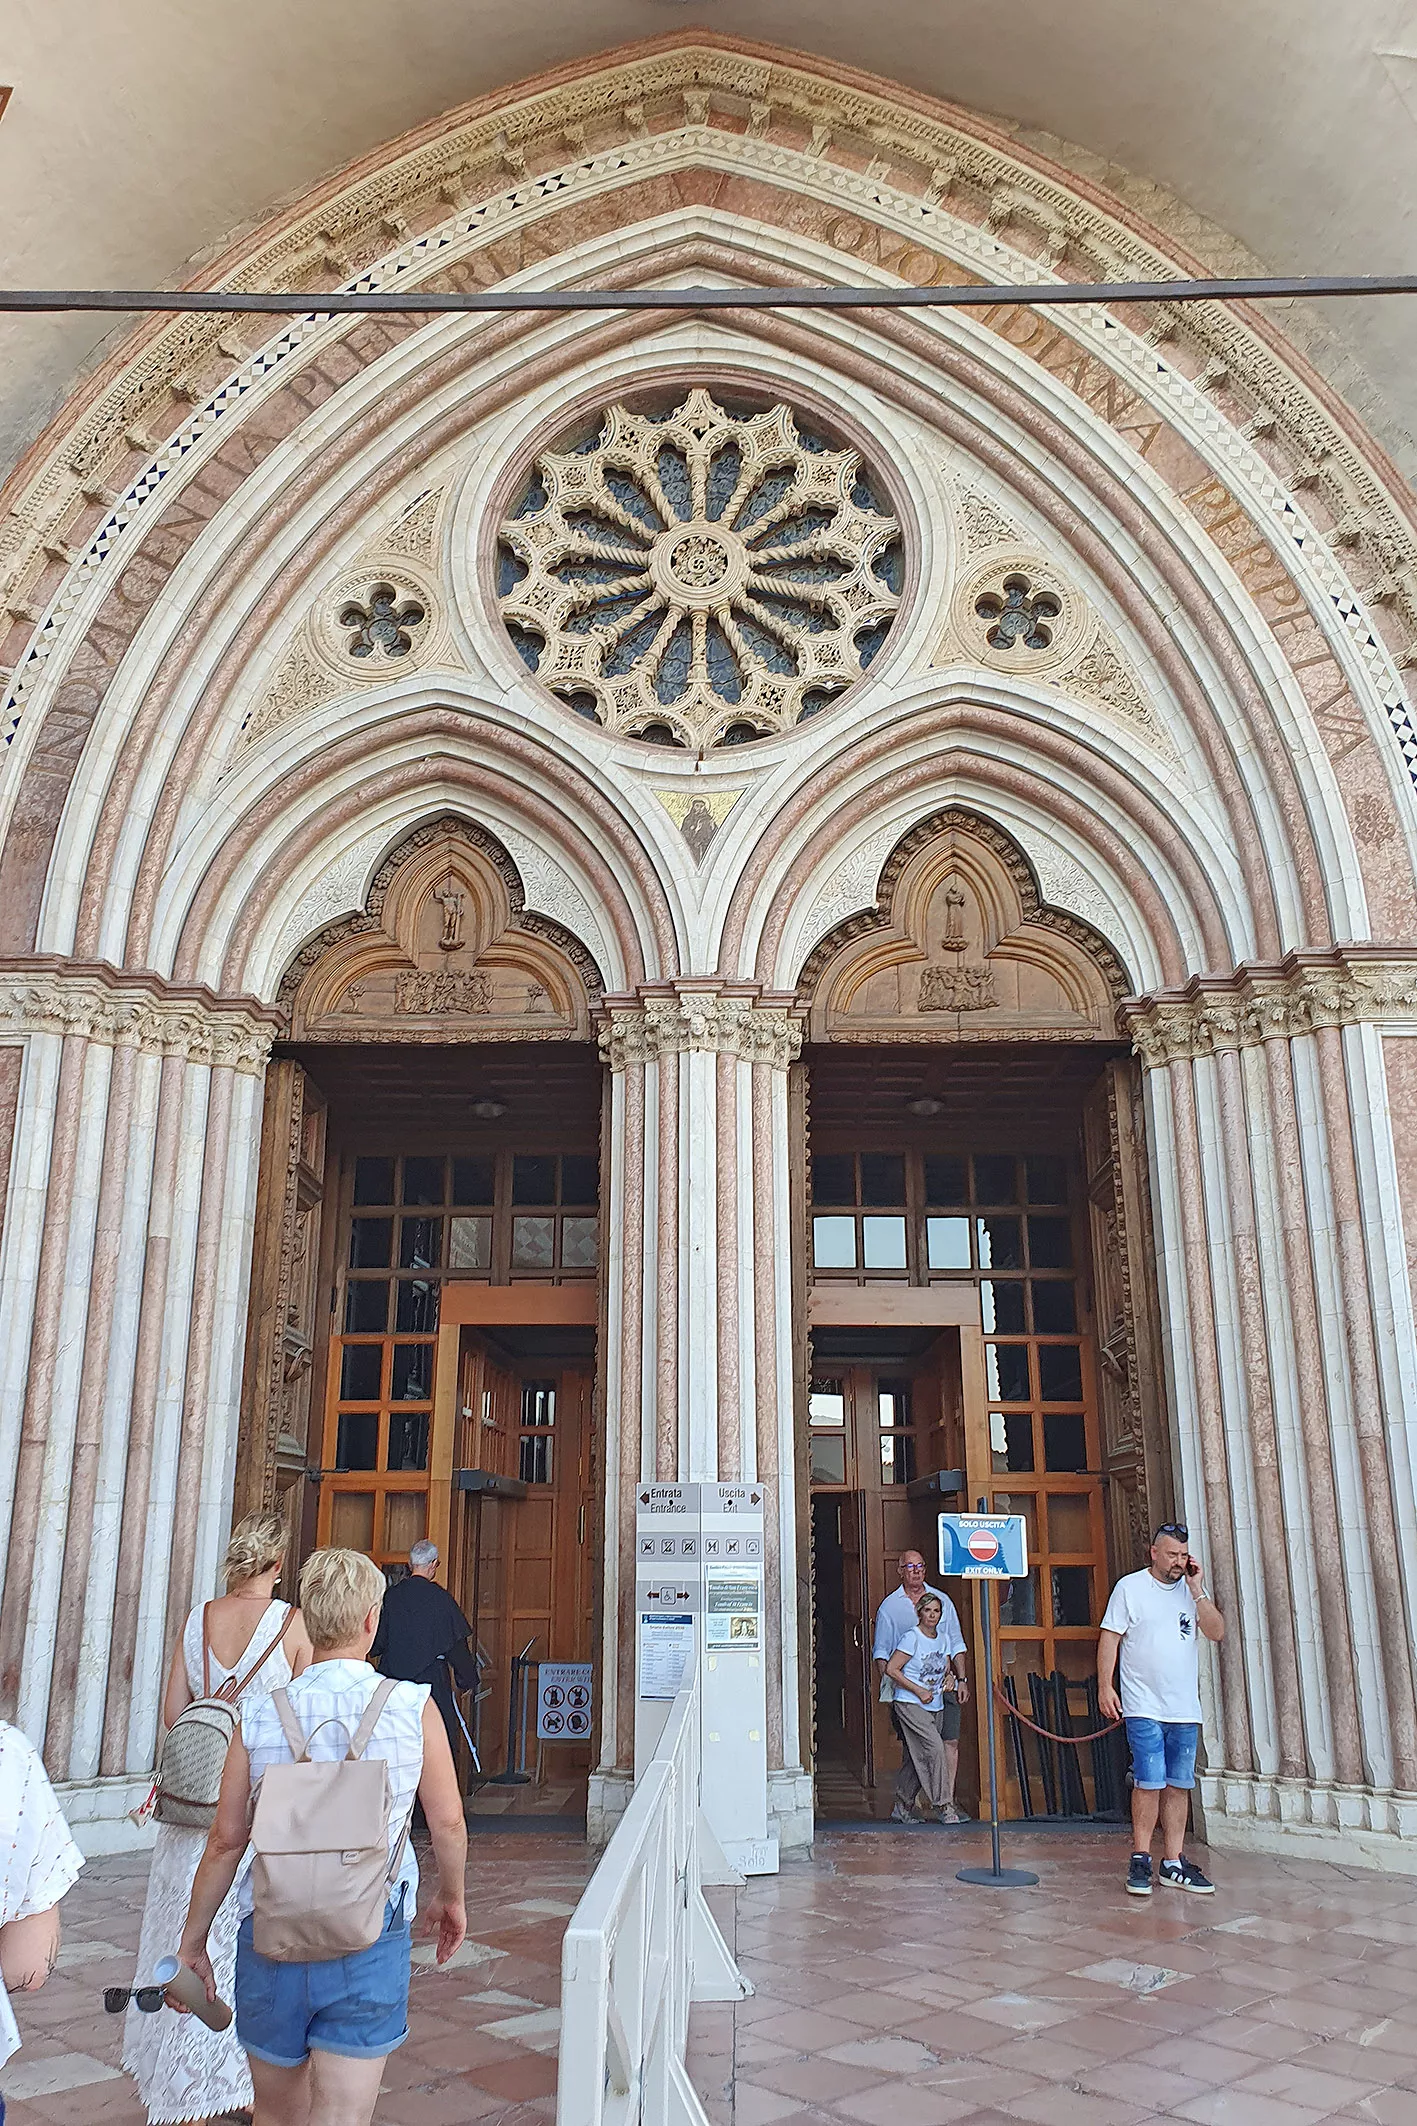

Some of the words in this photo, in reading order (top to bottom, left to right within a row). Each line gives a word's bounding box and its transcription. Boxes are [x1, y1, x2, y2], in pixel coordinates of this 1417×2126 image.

[283, 229, 557, 413] PLENRIA
[651, 1488, 682, 1498] Entrata
[719, 1488, 746, 1499] Uscita
[650, 1503, 687, 1513] Entrance
[723, 1503, 738, 1513] Exit
[959, 1520, 978, 1528] SOLO
[980, 1520, 1006, 1529] USCITA
[982, 1567, 1004, 1575] ONLY
